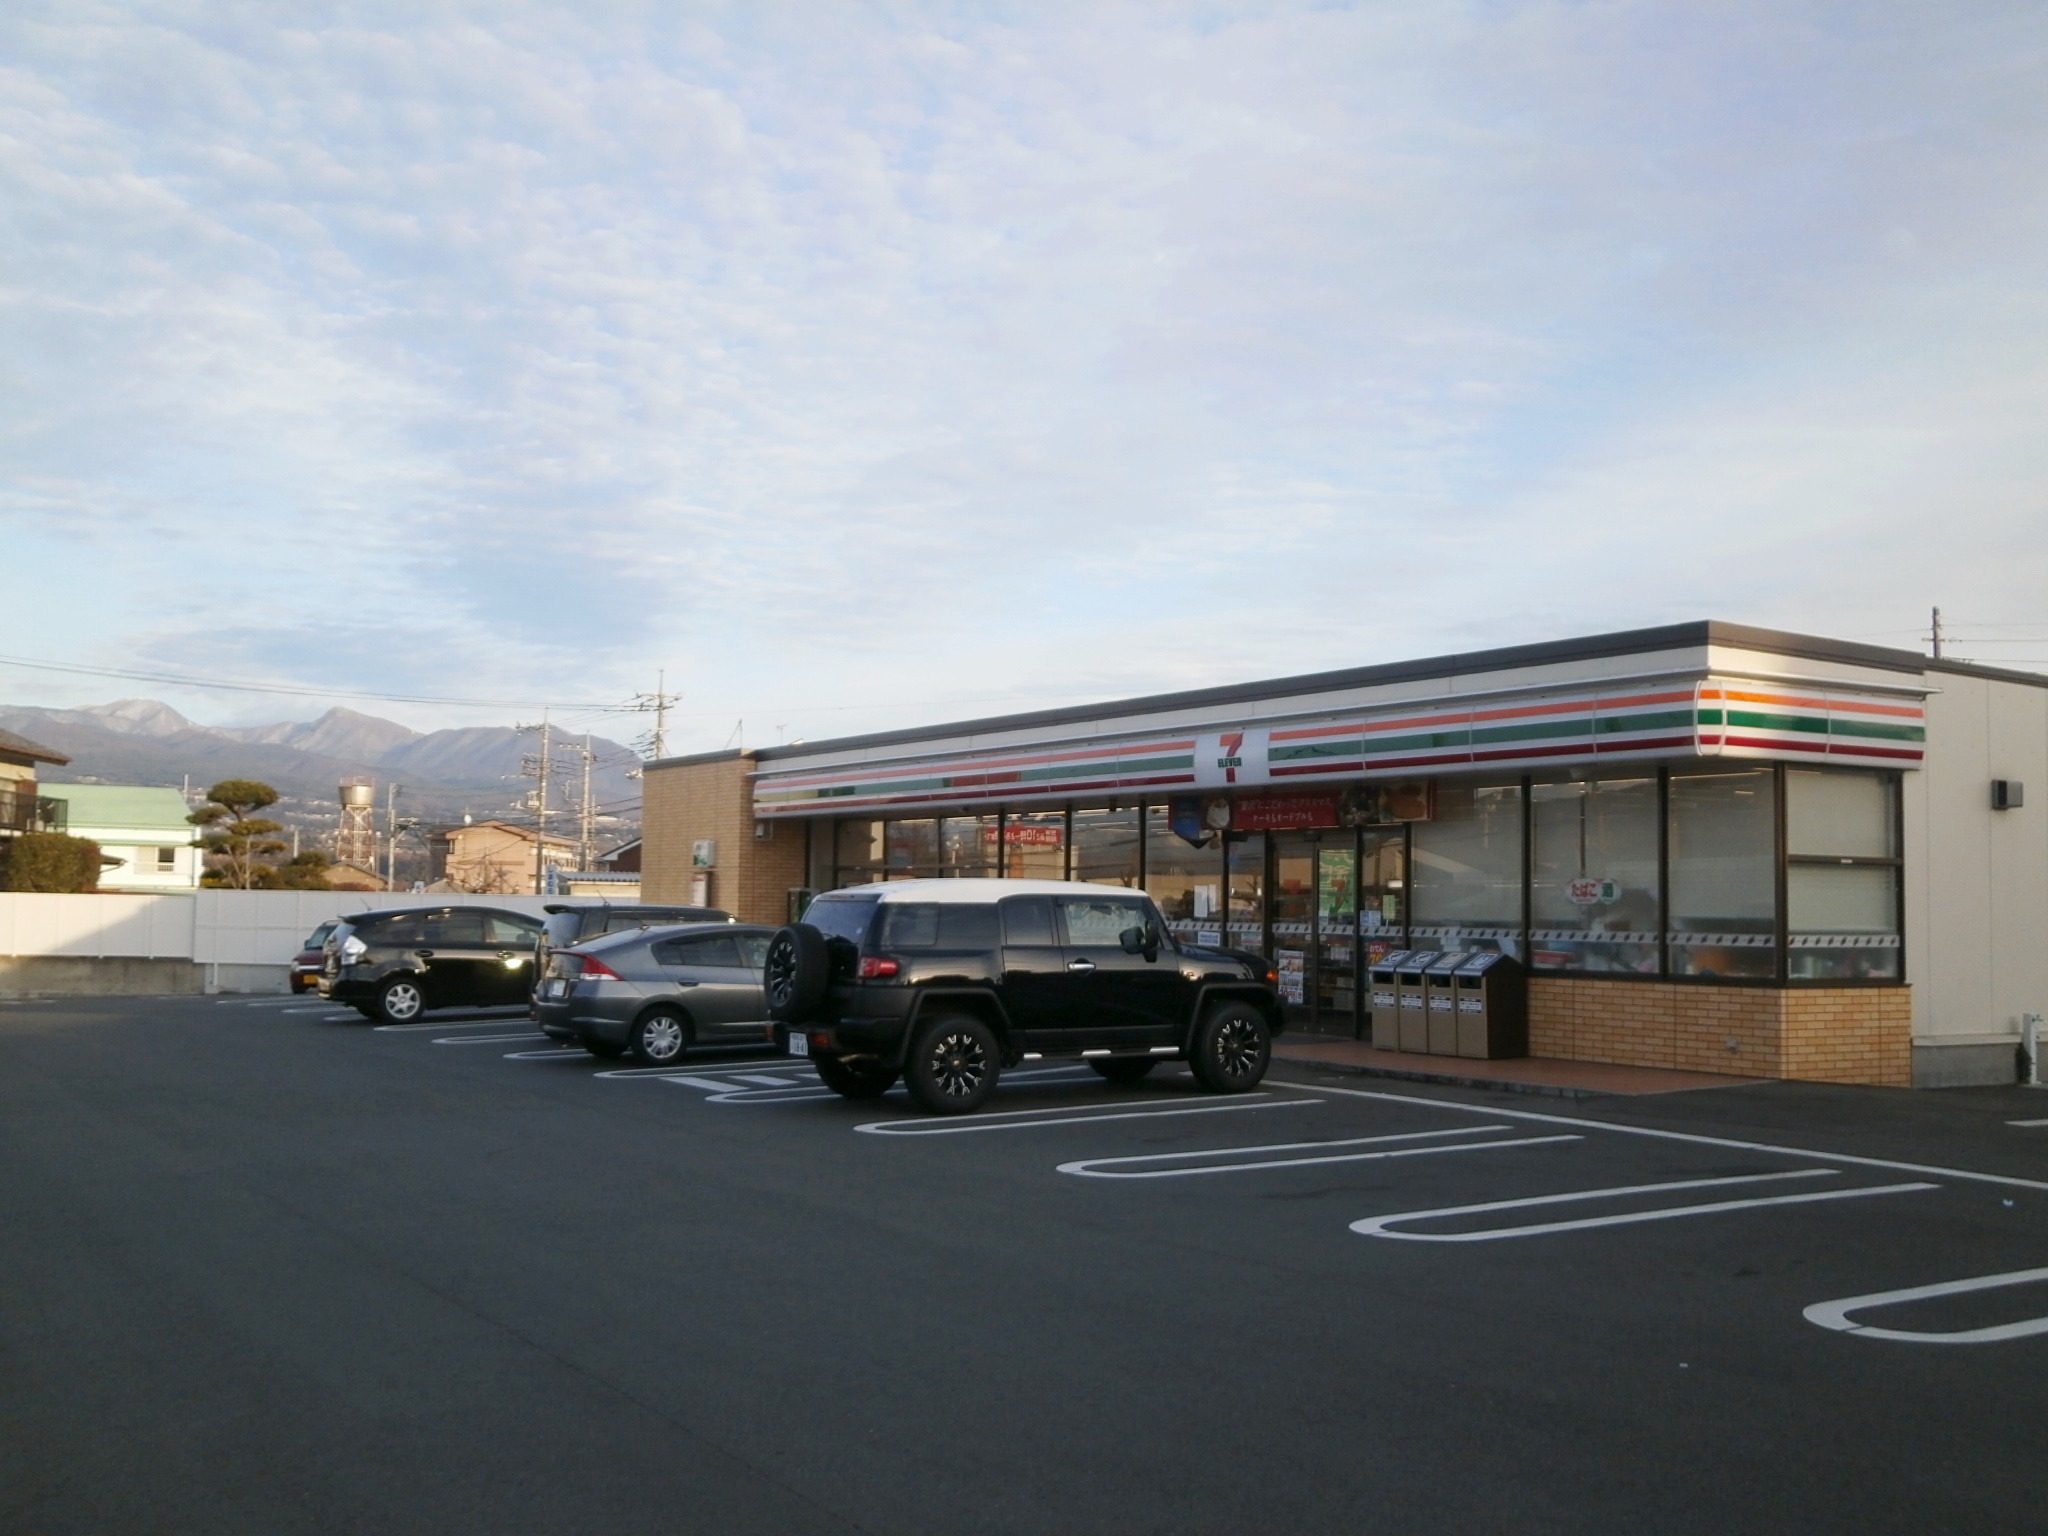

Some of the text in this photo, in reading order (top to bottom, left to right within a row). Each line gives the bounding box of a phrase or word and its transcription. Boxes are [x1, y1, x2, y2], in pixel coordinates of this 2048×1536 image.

[1220, 733, 1243, 782] 7
[1571, 882, 1597, 897] たばこ
[1602, 883, 1613, 897] 酒
[1369, 945, 1384, 953] おでん
